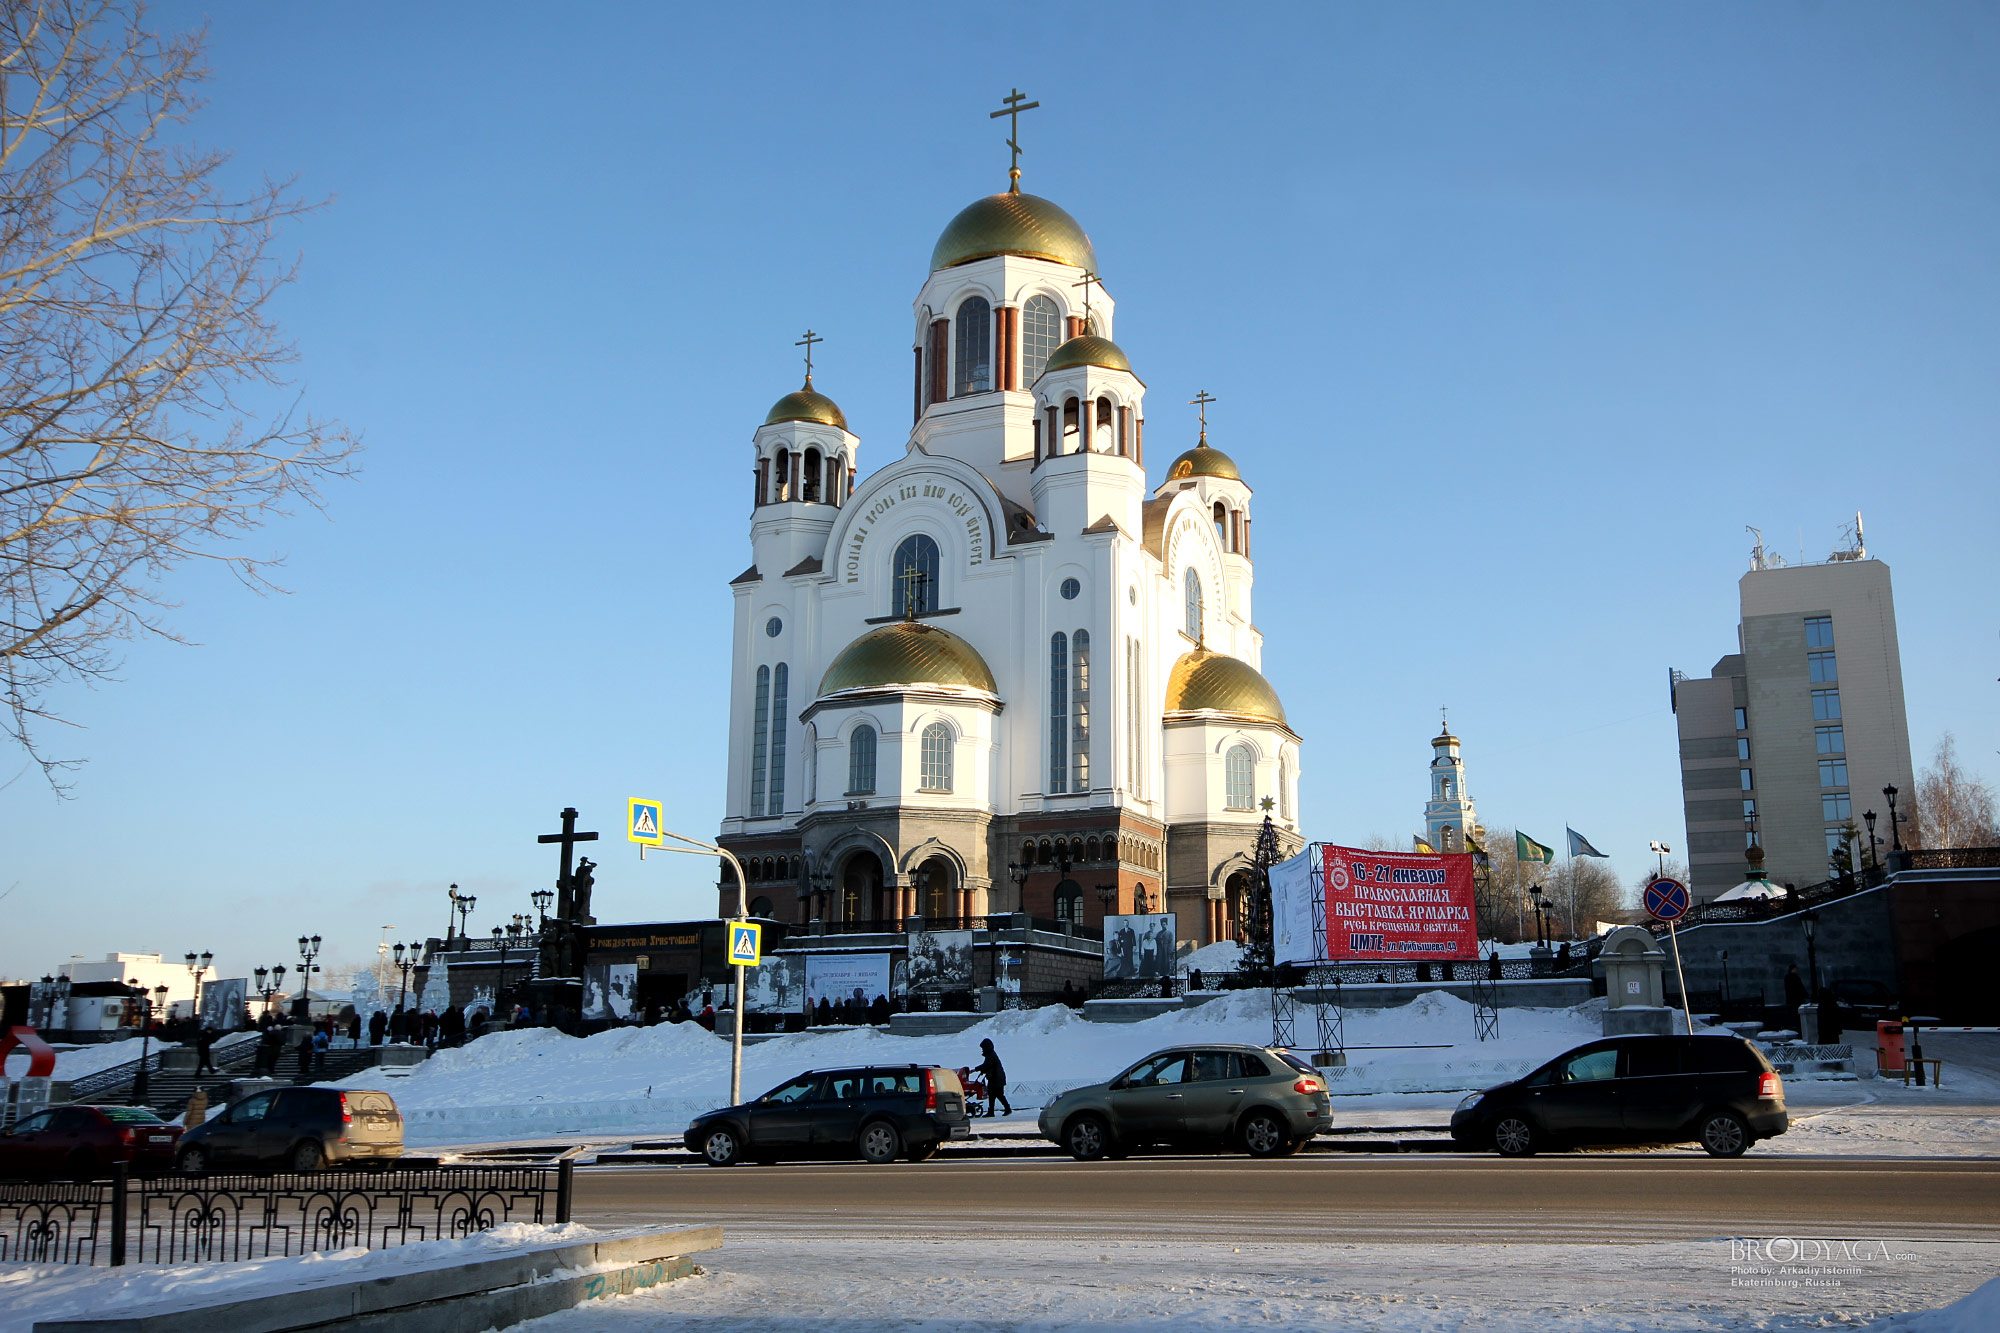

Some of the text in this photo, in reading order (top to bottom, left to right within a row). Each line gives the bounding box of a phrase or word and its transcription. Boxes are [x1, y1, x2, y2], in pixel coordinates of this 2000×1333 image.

[1351, 862, 1367, 881] 16
[1374, 864, 1391, 883] 21
[1392, 869, 1446, 886] января
[1353, 884, 1451, 903] ПРАВОСЛАВНАЯ
[1335, 901, 1470, 920] ВЫСТАВКА-ЯРМАРКА
